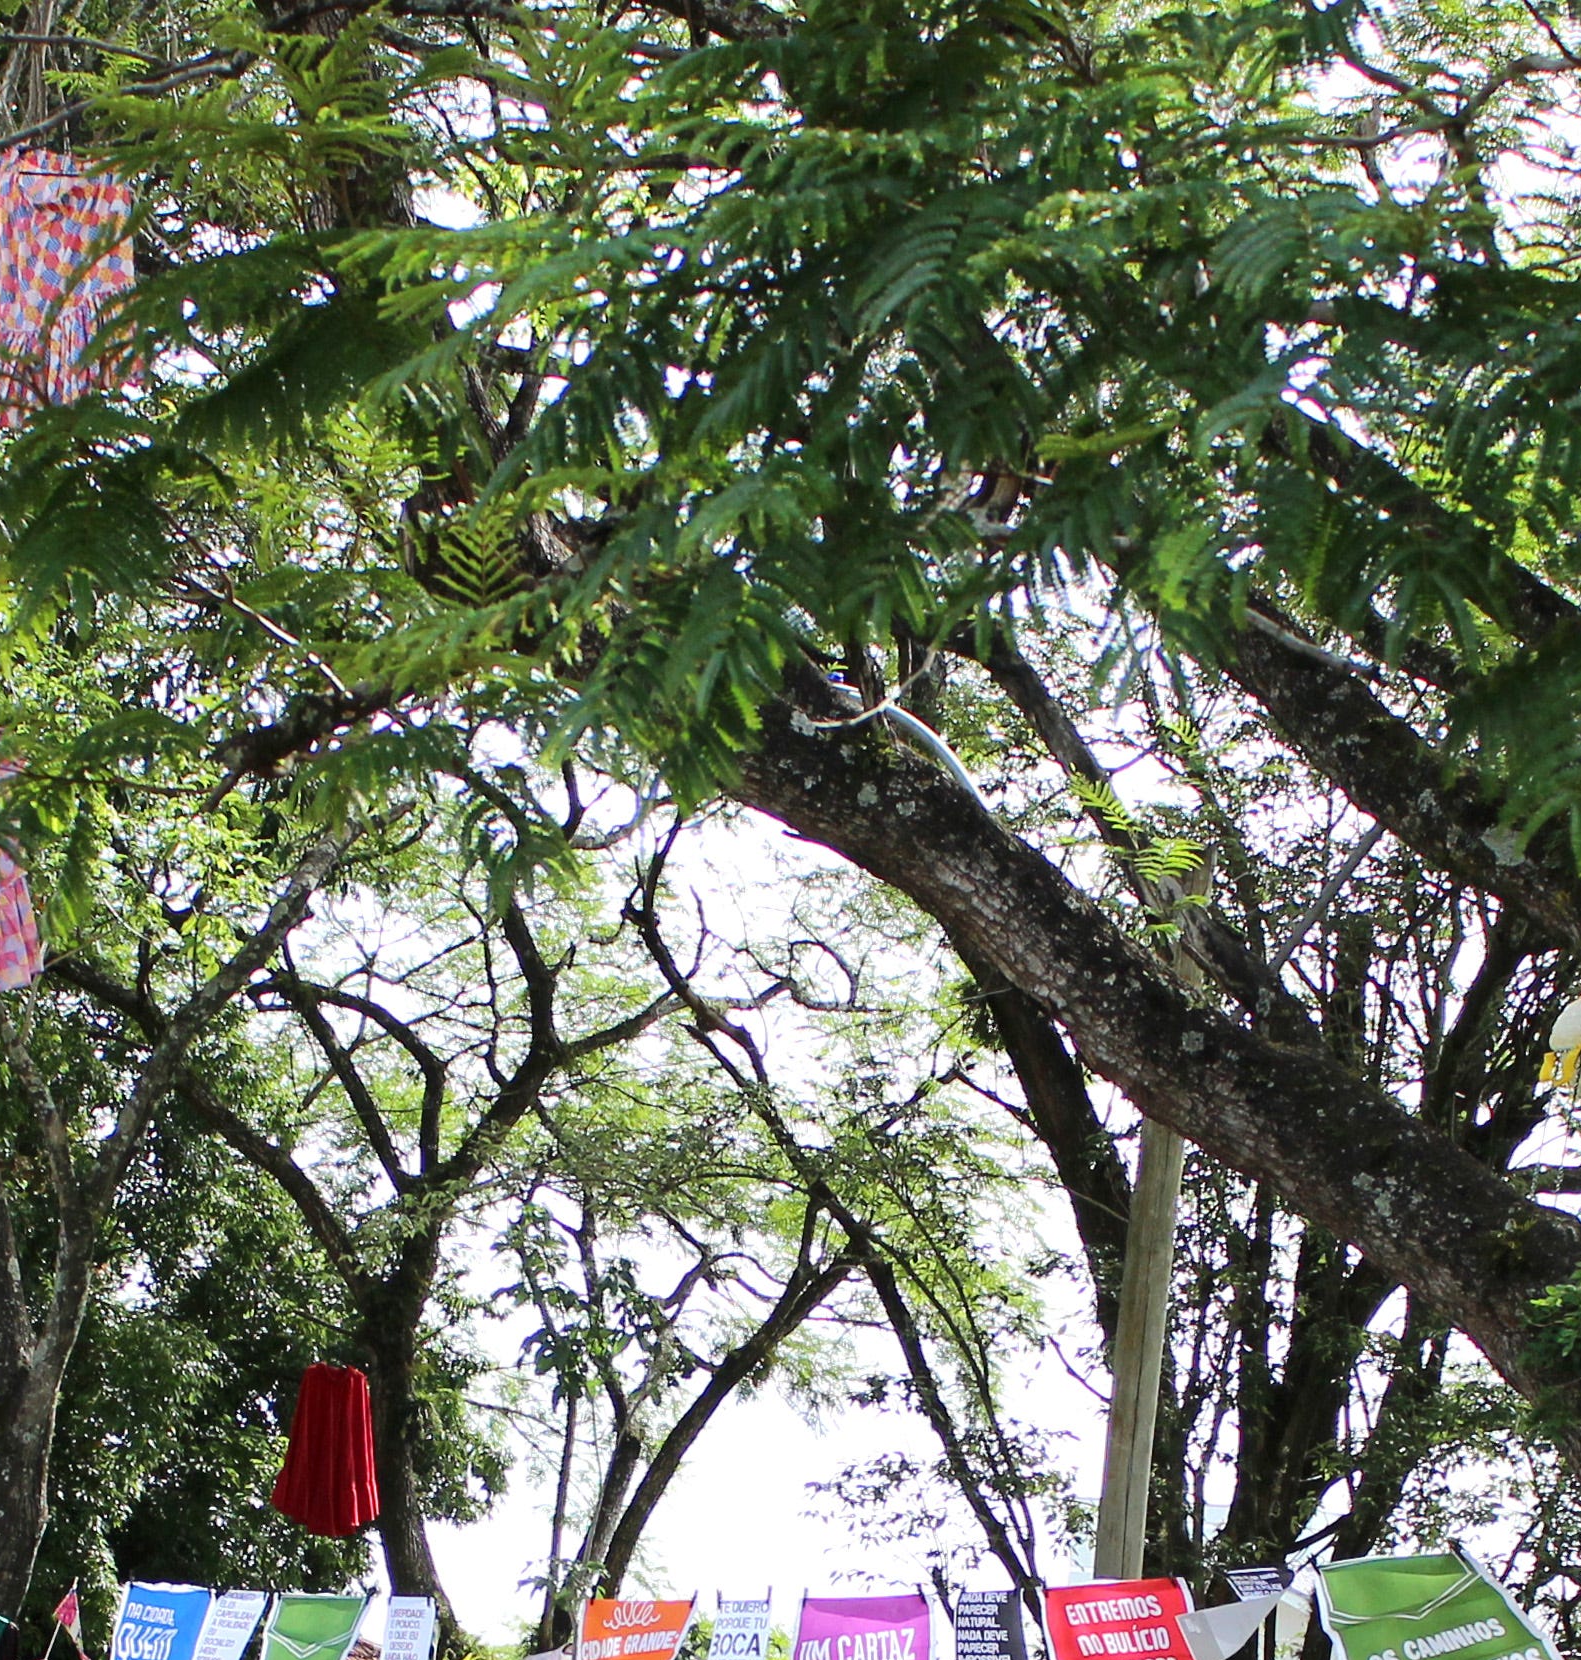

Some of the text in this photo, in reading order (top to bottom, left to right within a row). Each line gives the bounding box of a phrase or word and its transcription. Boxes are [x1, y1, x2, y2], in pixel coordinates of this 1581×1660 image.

[959, 1592, 1008, 1603] NADA DEVE
[126, 1602, 143, 1619] NA
[731, 1601, 769, 1614] QUIERO
[958, 1604, 999, 1615] PARECER
[1065, 1594, 1163, 1626] ENTREMOS
[716, 1617, 768, 1629] PORQUE TU
[957, 1616, 1000, 1628] NATURAL.
[957, 1629, 1009, 1641] NADA DEVE
[1077, 1624, 1171, 1657] NO BULÍCIO
[623, 1630, 680, 1655] GRANDE:
[710, 1632, 761, 1657] BOCA
[958, 1642, 1000, 1654] PARECER
